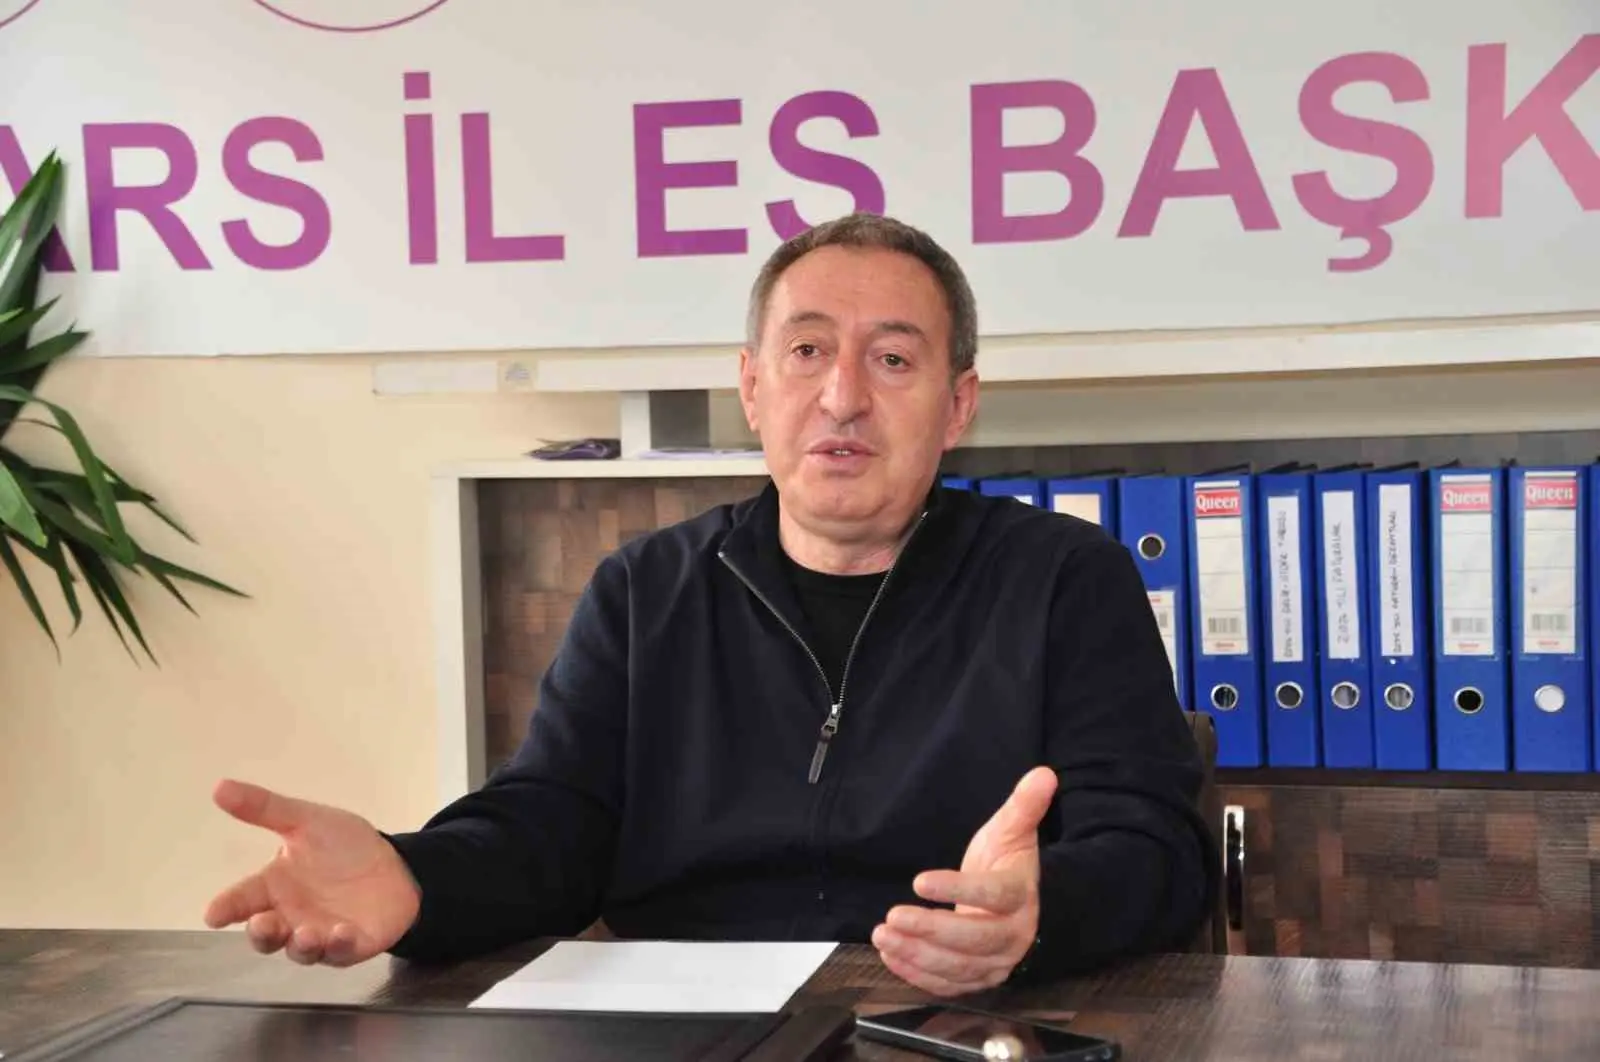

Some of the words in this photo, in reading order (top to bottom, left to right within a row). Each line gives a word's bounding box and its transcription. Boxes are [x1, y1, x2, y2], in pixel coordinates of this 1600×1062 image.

[403, 71, 566, 265] İL
[970, 33, 1600, 273] BAŞK
[1196, 494, 1239, 512] Queen
[1442, 488, 1490, 507] Queen
